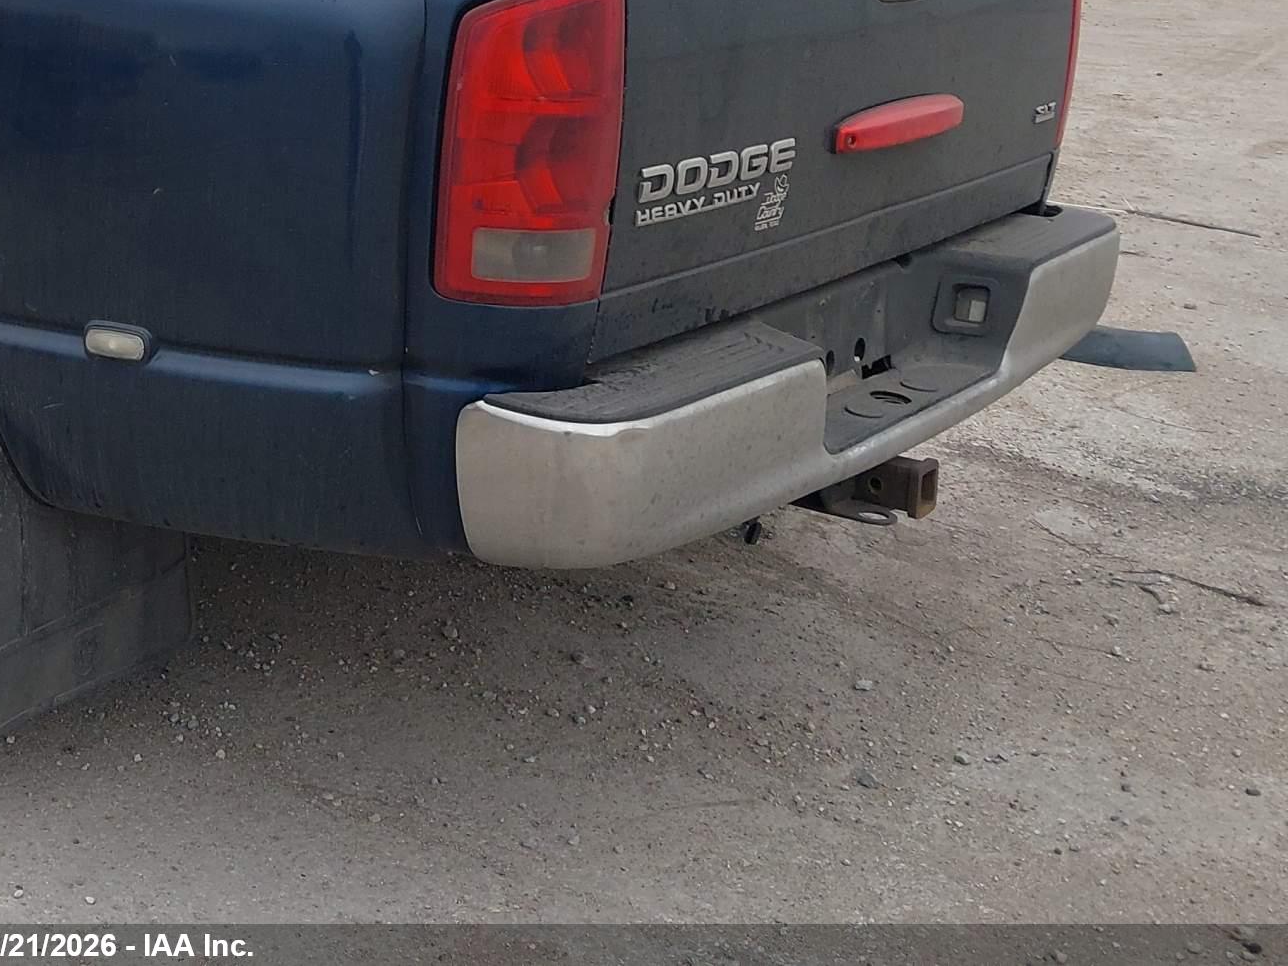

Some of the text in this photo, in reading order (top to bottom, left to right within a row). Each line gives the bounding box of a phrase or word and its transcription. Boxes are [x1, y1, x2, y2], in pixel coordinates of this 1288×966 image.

[639, 137, 796, 204] DODGE
[634, 182, 761, 227] HEAVY DUTY
